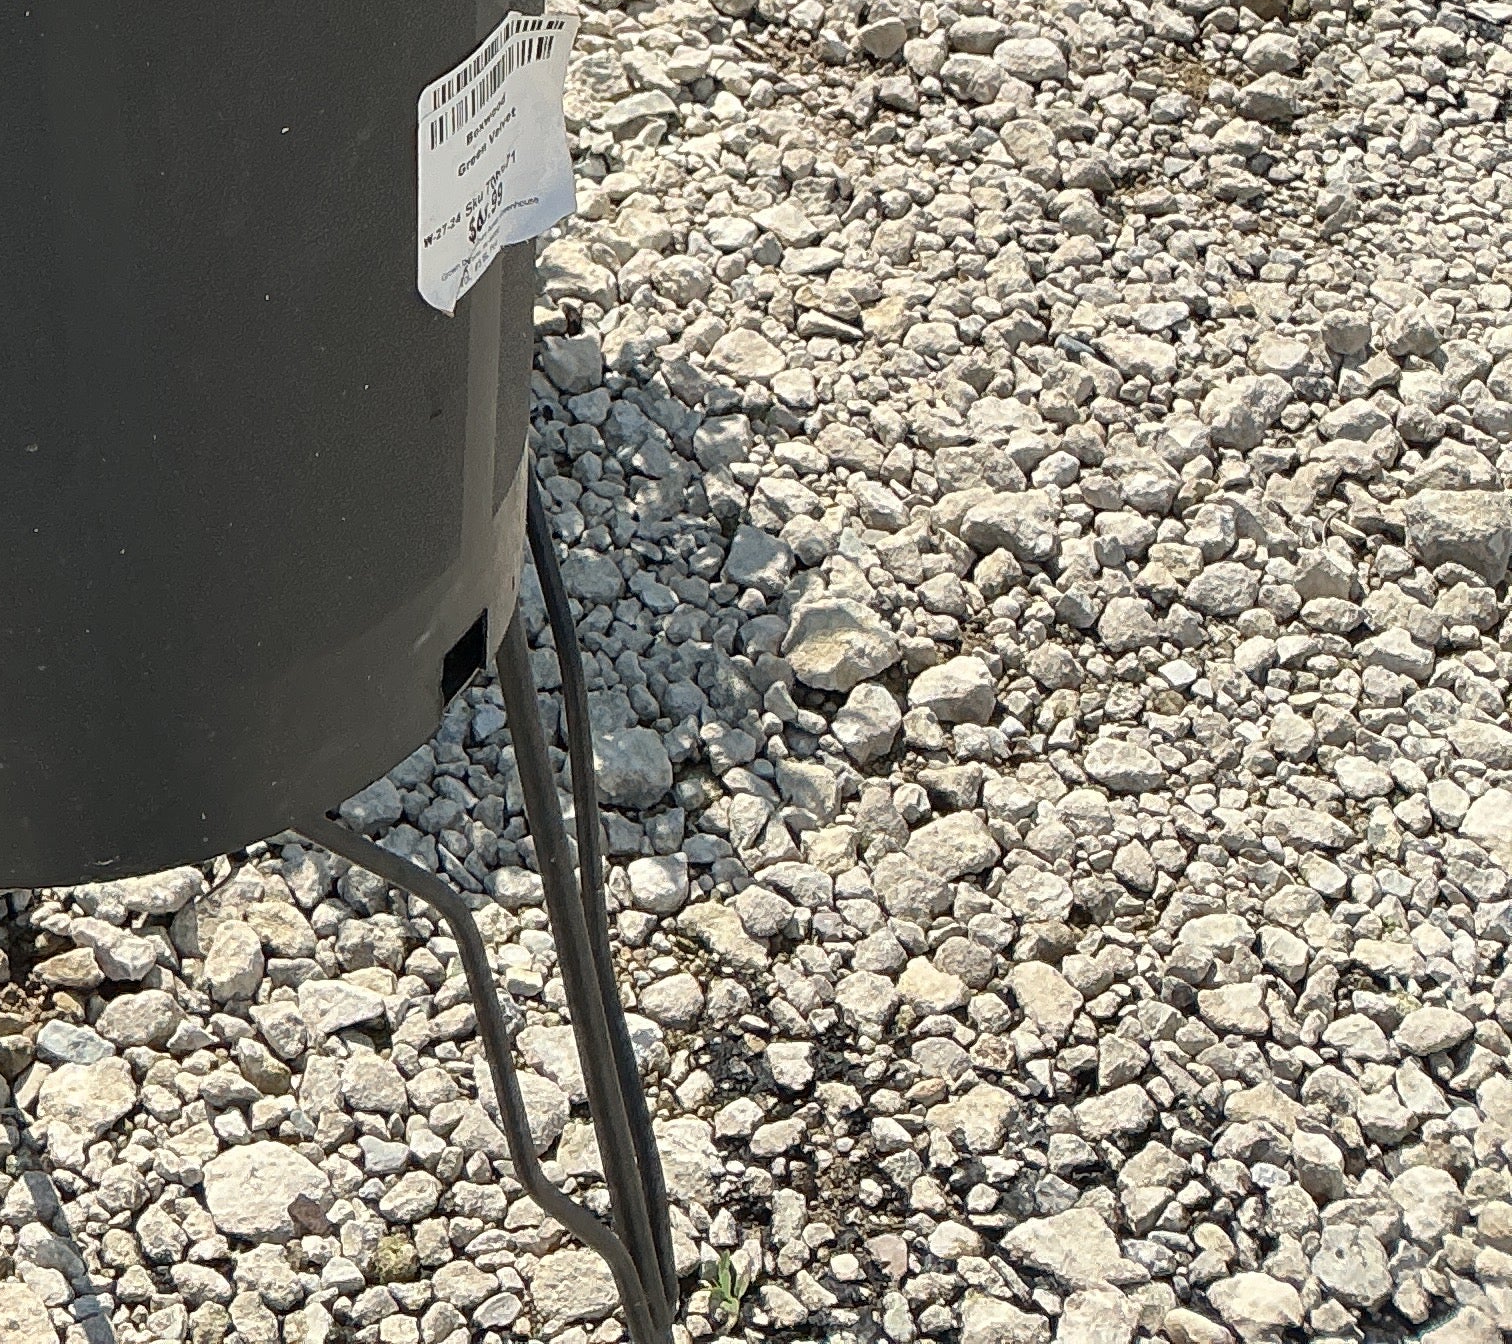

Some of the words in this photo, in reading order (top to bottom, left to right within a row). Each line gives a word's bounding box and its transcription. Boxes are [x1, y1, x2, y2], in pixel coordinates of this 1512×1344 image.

[457, 142, 487, 177] Green
[488, 106, 517, 145] Velvet
[466, 92, 506, 146] Boxwood
[465, 190, 484, 218] Sku
